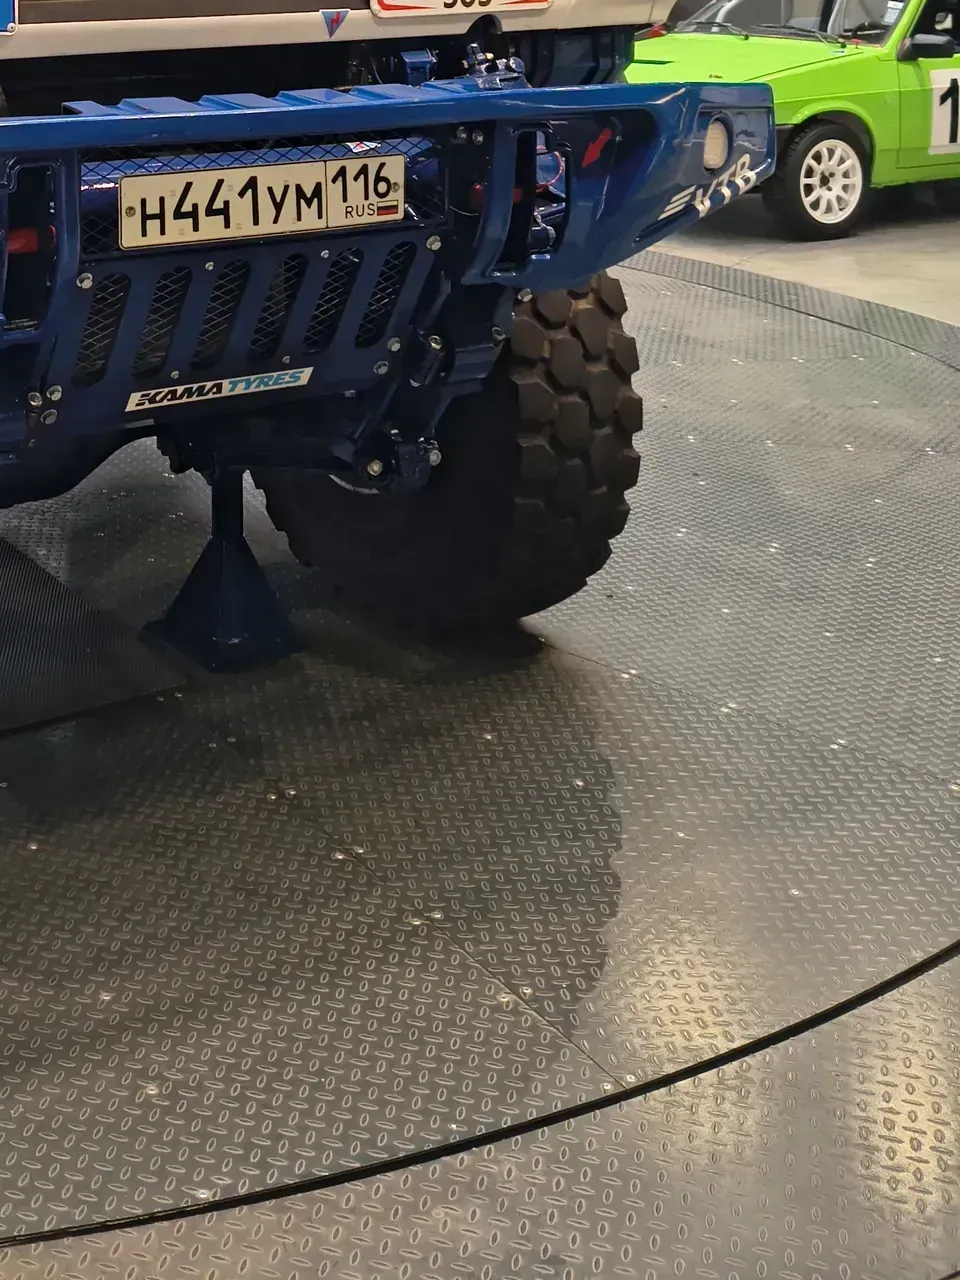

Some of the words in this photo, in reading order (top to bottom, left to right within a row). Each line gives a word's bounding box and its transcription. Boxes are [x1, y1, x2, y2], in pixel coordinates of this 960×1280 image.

[330, 161, 392, 204] 116
[344, 203, 376, 219] RUS
[134, 382, 224, 408] KAMA
[227, 370, 306, 394] TYRES
